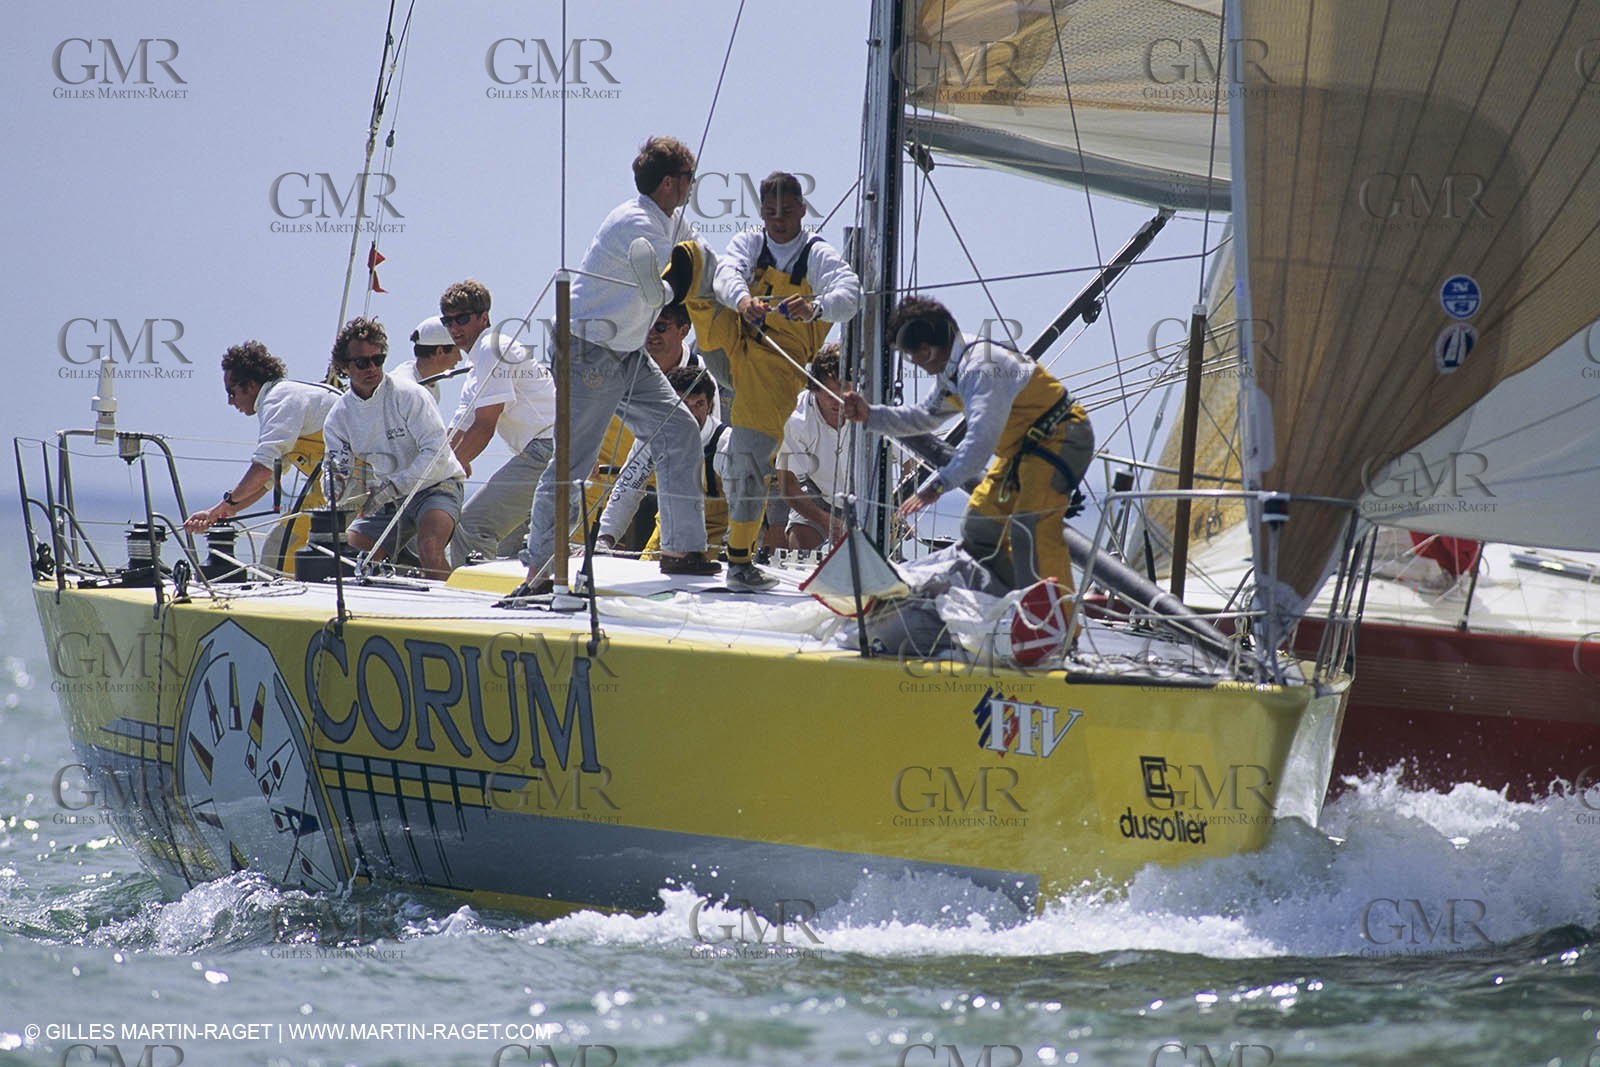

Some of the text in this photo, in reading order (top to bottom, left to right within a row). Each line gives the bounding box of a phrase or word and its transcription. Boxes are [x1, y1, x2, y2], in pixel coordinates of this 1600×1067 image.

[305, 628, 600, 773] CORUM
[986, 698, 1084, 758] FFV
[1119, 806, 1209, 844] dusolier
